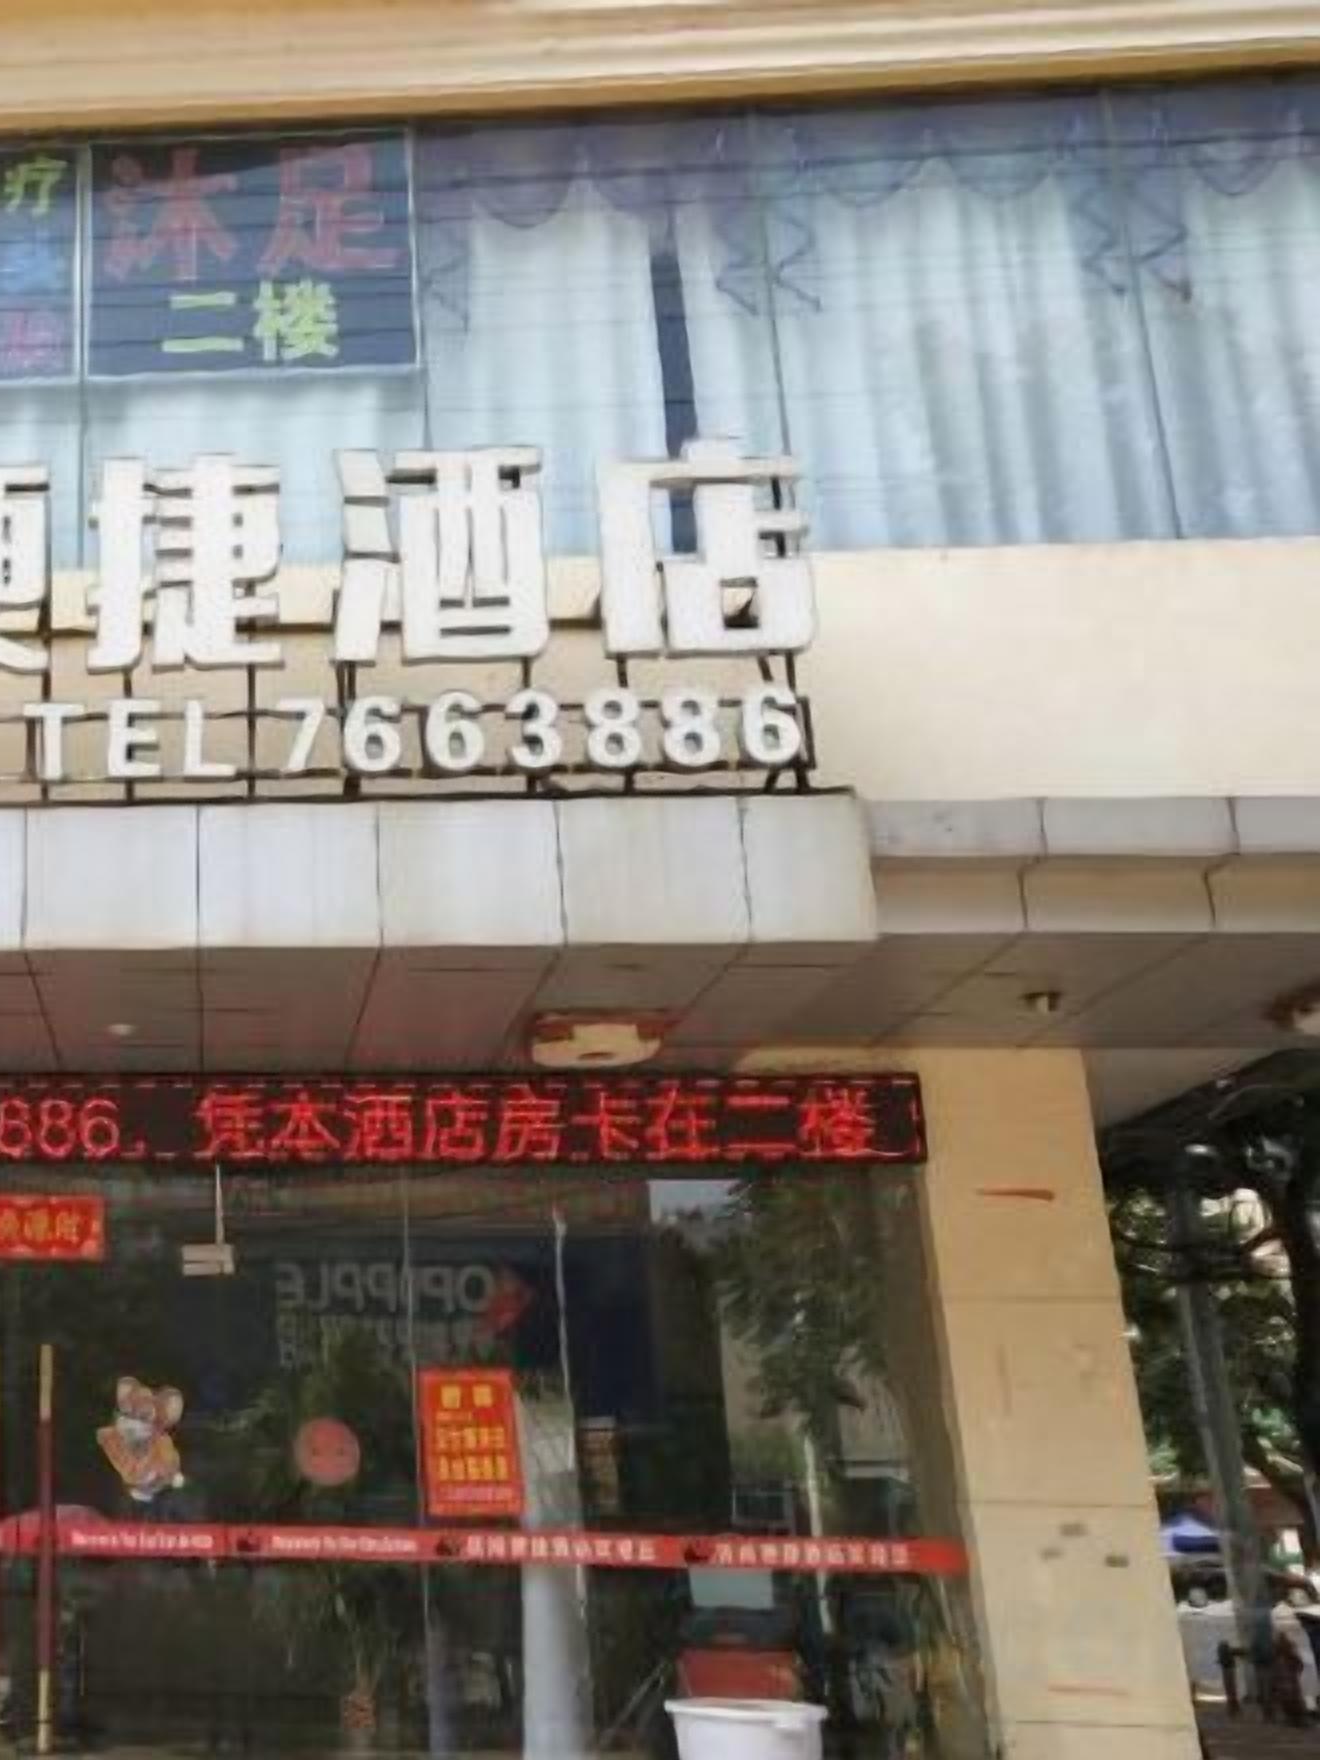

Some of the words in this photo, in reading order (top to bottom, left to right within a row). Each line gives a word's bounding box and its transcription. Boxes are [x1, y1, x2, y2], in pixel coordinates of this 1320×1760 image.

[101, 145, 406, 281] 沐足
[161, 279, 339, 362] 二楼
[23, 698, 237, 781] TEL
[279, 684, 803, 773] 7663886
